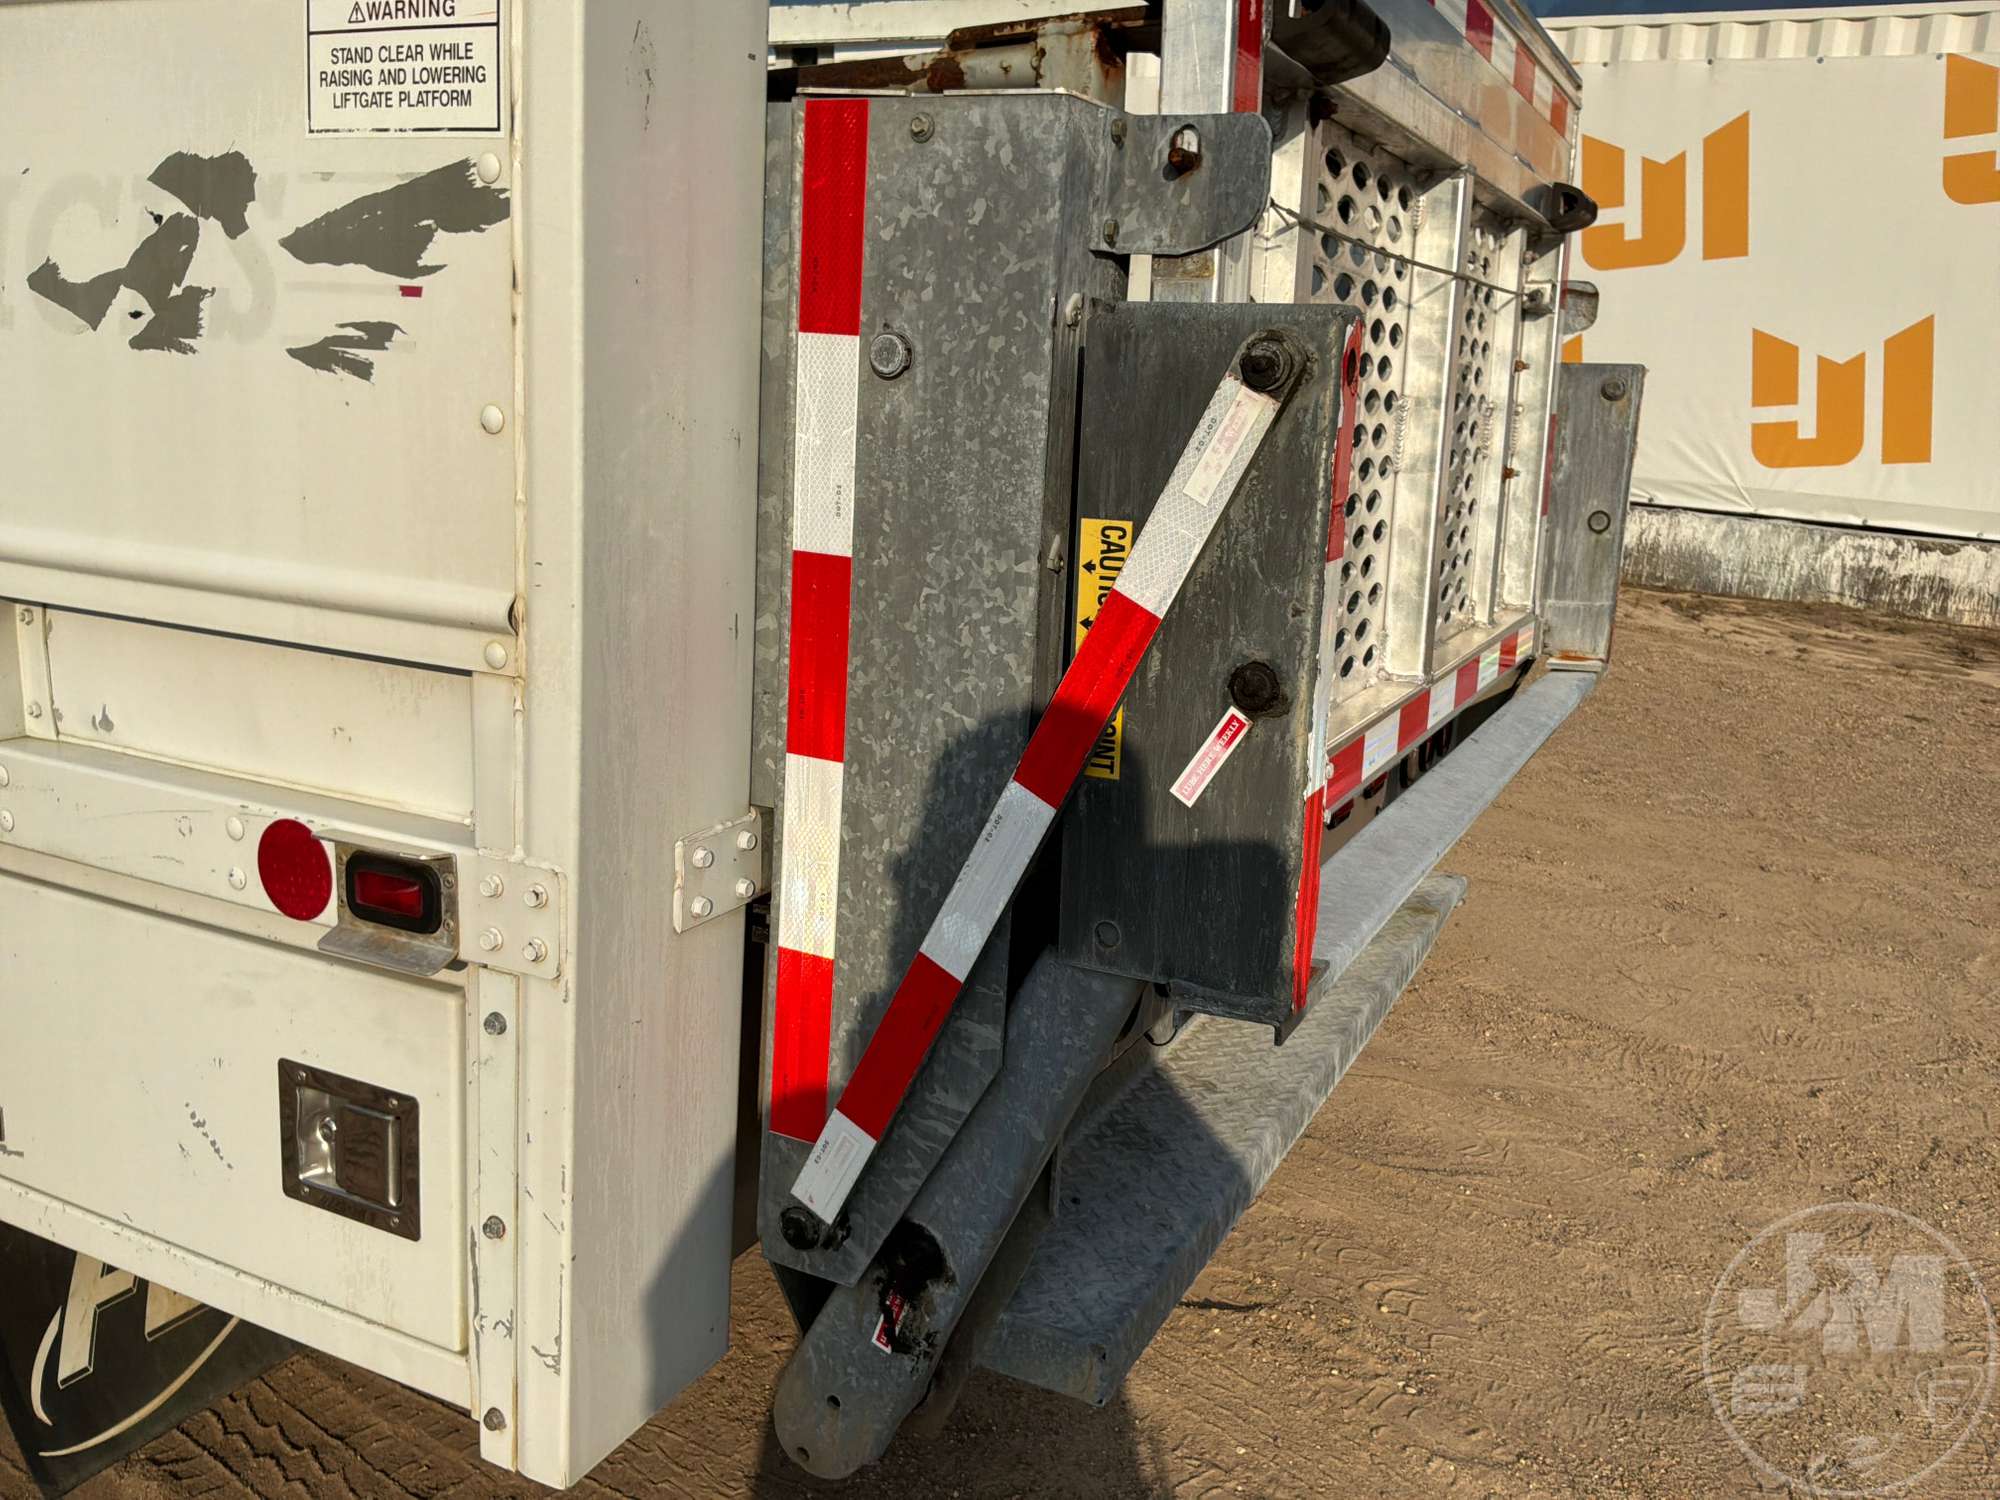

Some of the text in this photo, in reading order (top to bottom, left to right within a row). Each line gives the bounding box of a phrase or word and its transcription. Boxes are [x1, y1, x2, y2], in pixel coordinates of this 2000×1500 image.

[366, 0, 455, 20] WARNING
[331, 42, 473, 65] STAND CLEAR WHILE
[320, 66, 486, 87] RAISING AND LOWERING
[333, 90, 471, 109] LIFTGATE PLATFORM
[1212, 719, 1240, 753] WEEKLY
